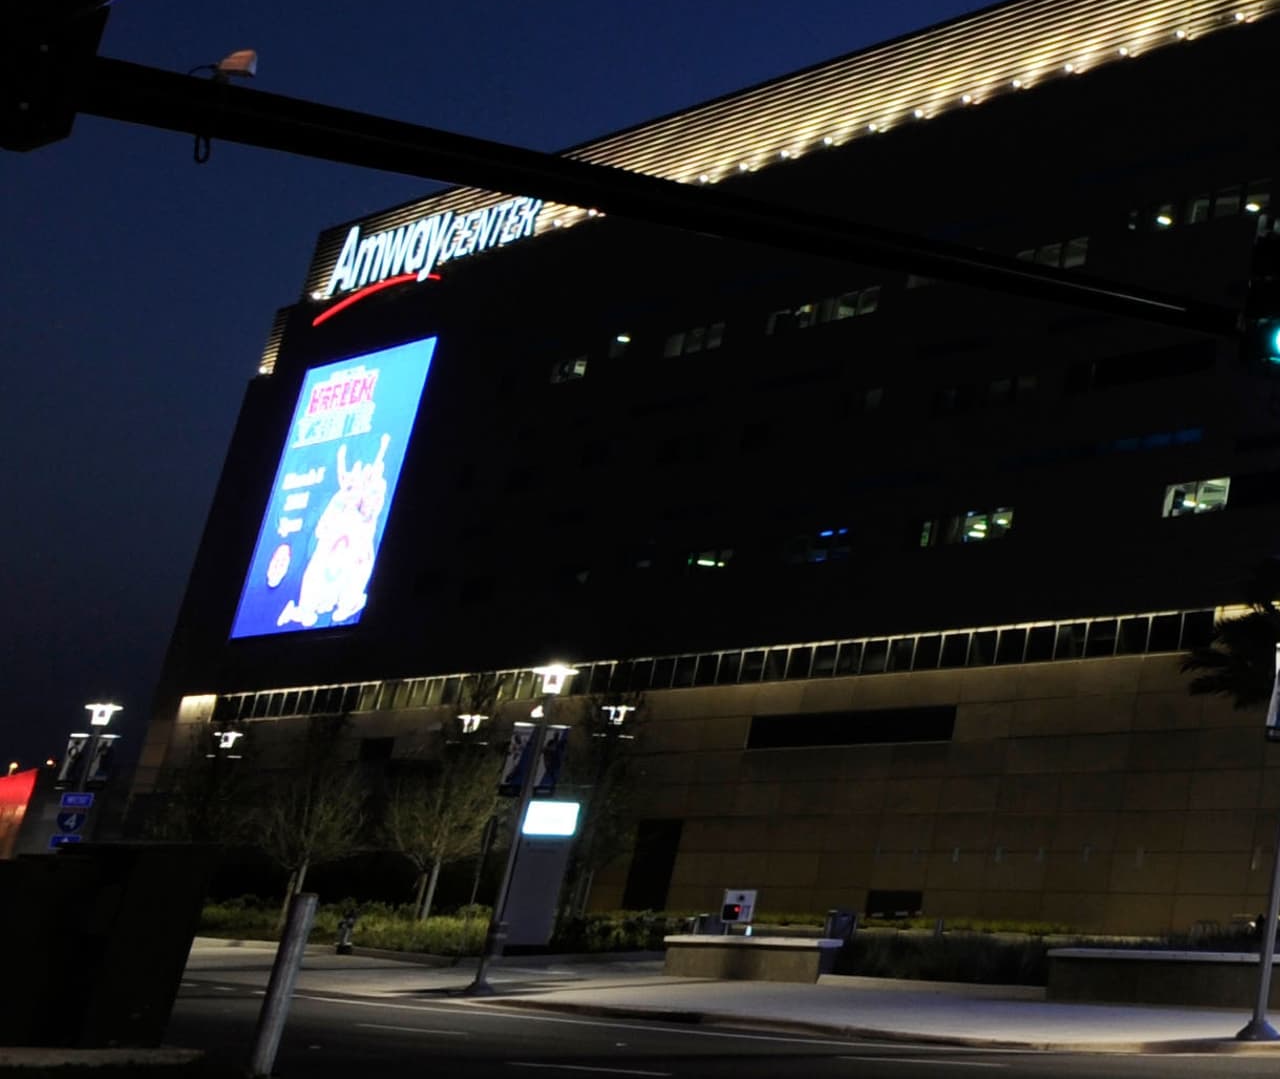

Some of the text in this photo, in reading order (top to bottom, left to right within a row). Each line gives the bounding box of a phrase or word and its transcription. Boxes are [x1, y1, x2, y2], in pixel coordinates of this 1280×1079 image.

[326, 196, 543, 296] Amway CENTER
[64, 813, 77, 829] 4
